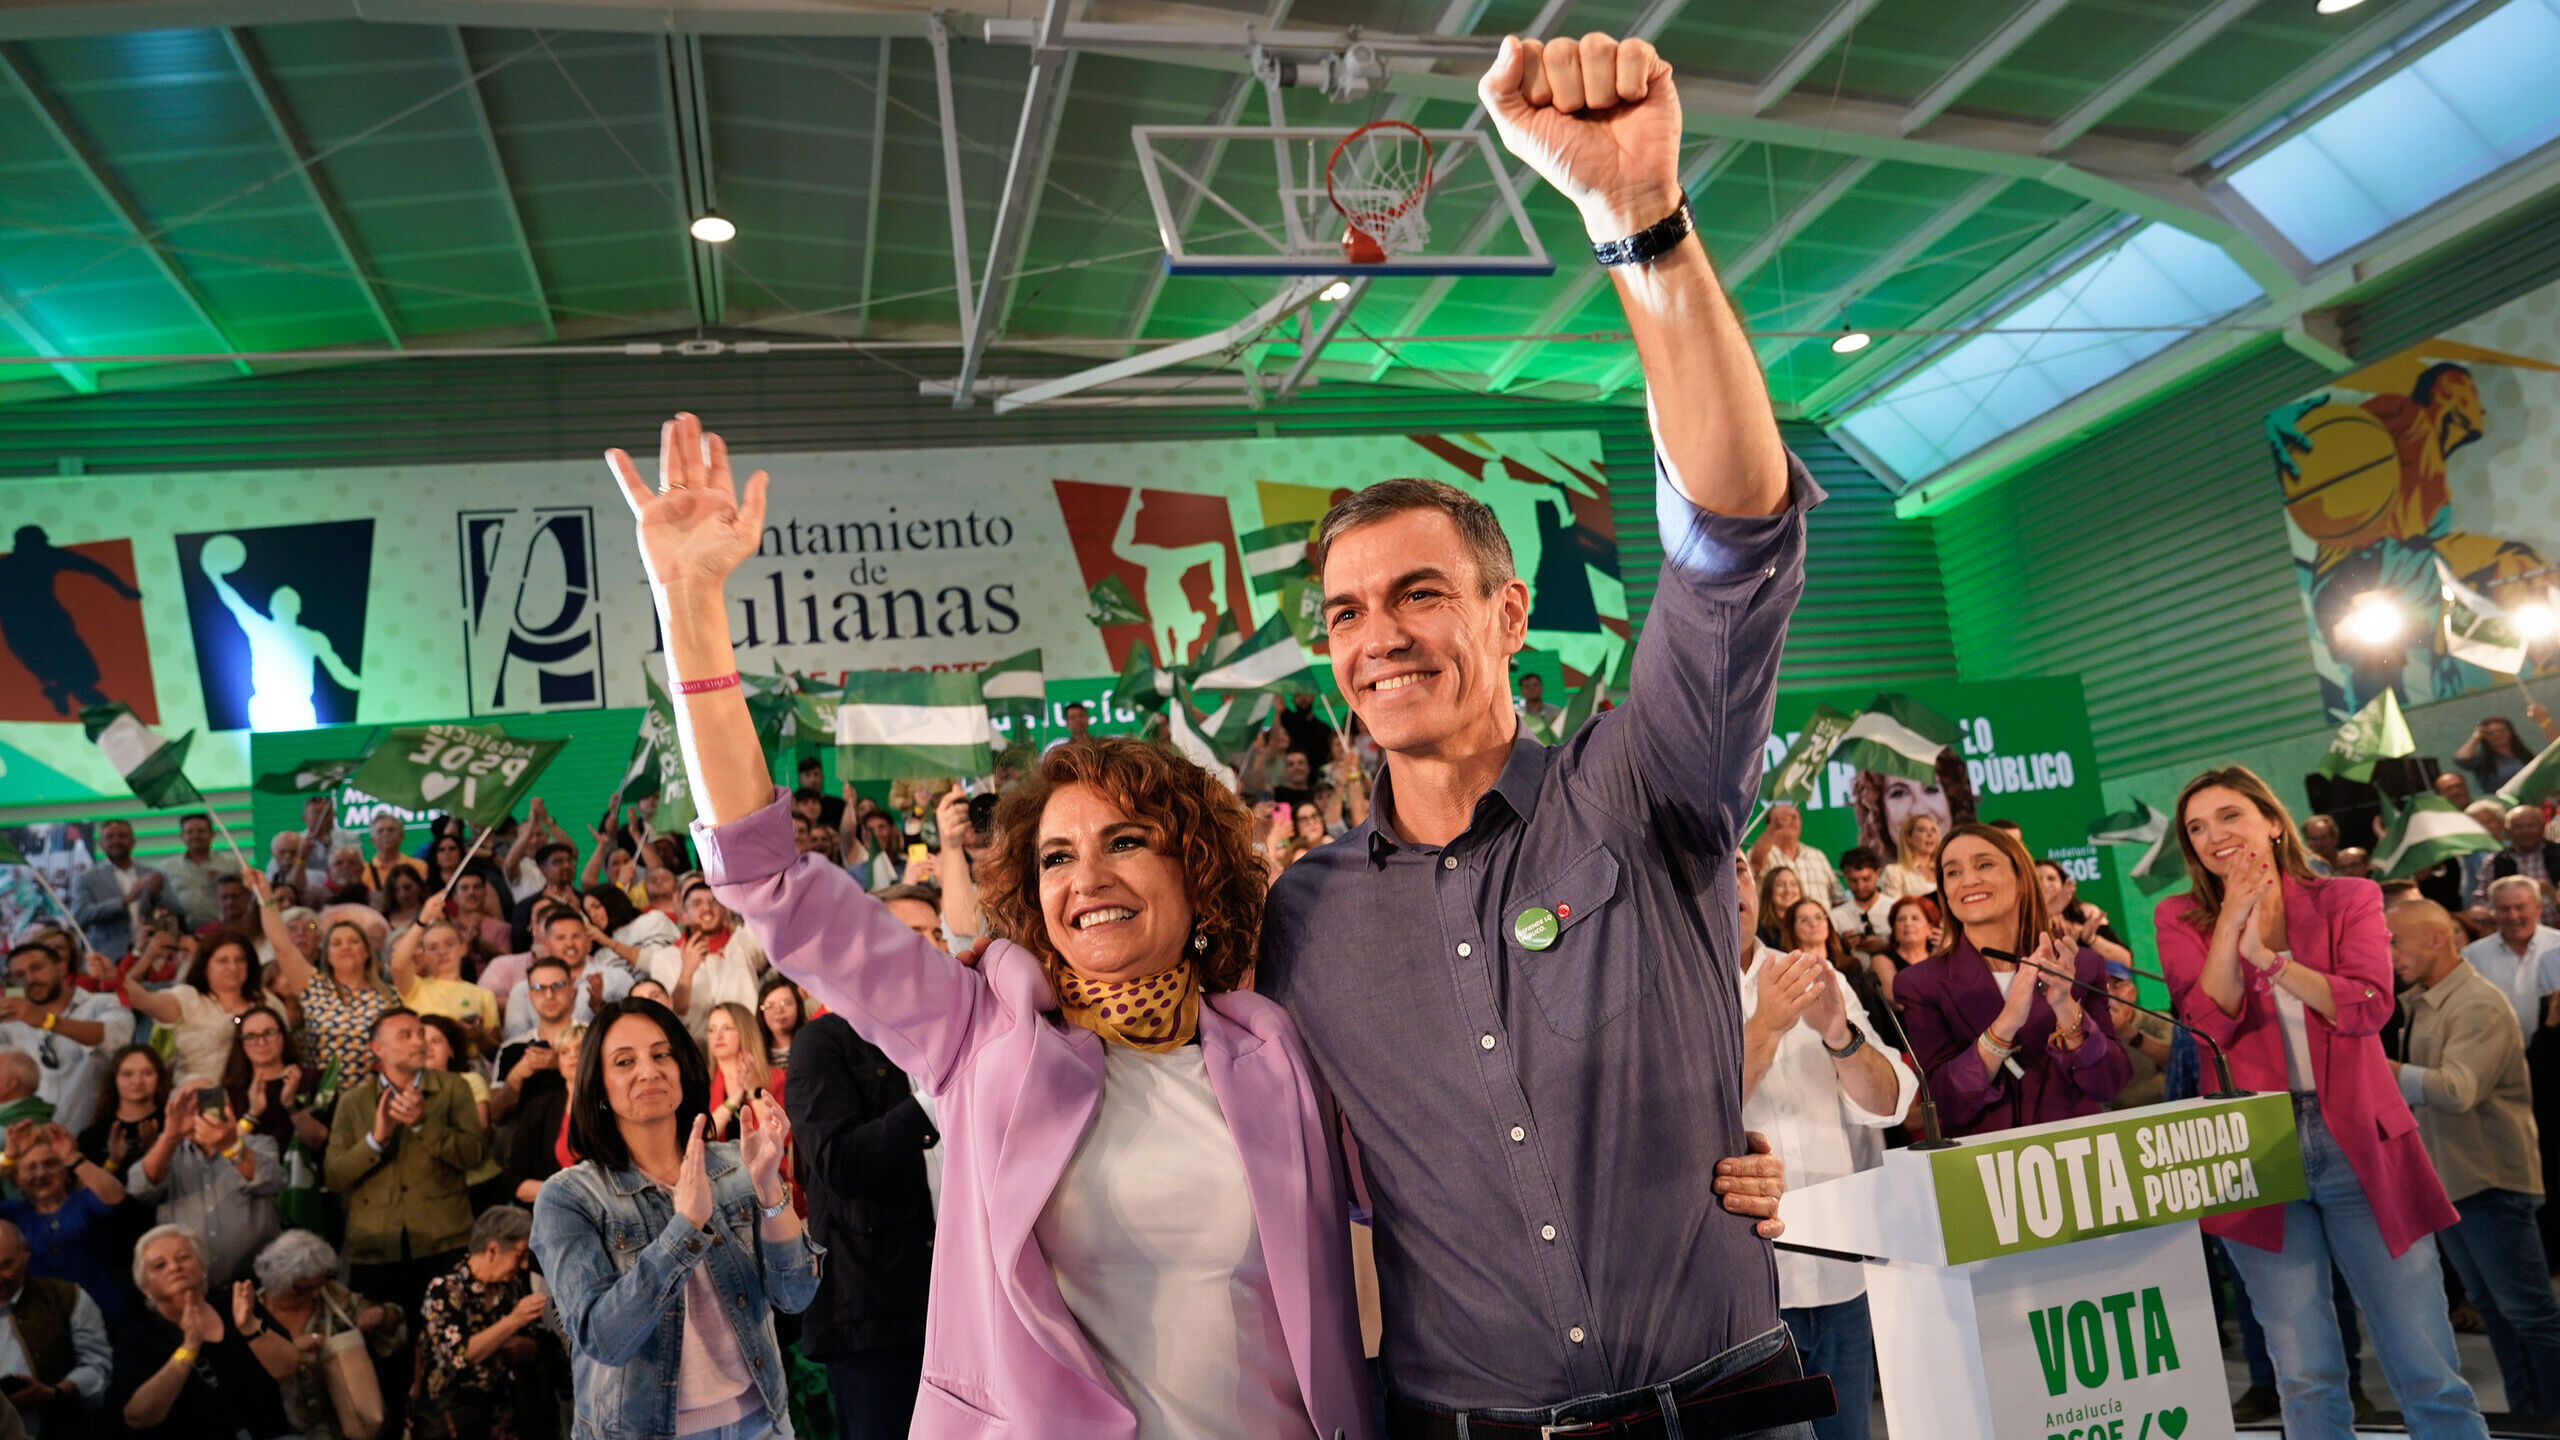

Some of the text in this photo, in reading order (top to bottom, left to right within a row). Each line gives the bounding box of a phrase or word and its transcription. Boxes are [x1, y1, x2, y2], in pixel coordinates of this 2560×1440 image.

[754, 505, 1014, 560] ntamiento
[848, 557, 889, 587] de
[1961, 716, 1994, 755] LO
[1967, 751, 2075, 797] PÚBLICO
[2061, 856, 2102, 882] SOE
[2135, 1111, 2250, 1169] SANIDAD
[1975, 1132, 2139, 1246] VOTA
[2143, 1157, 2260, 1218] PÚBLICA
[2028, 1286, 2181, 1397] VOTA
[2045, 1397, 2124, 1428] Andalucía
